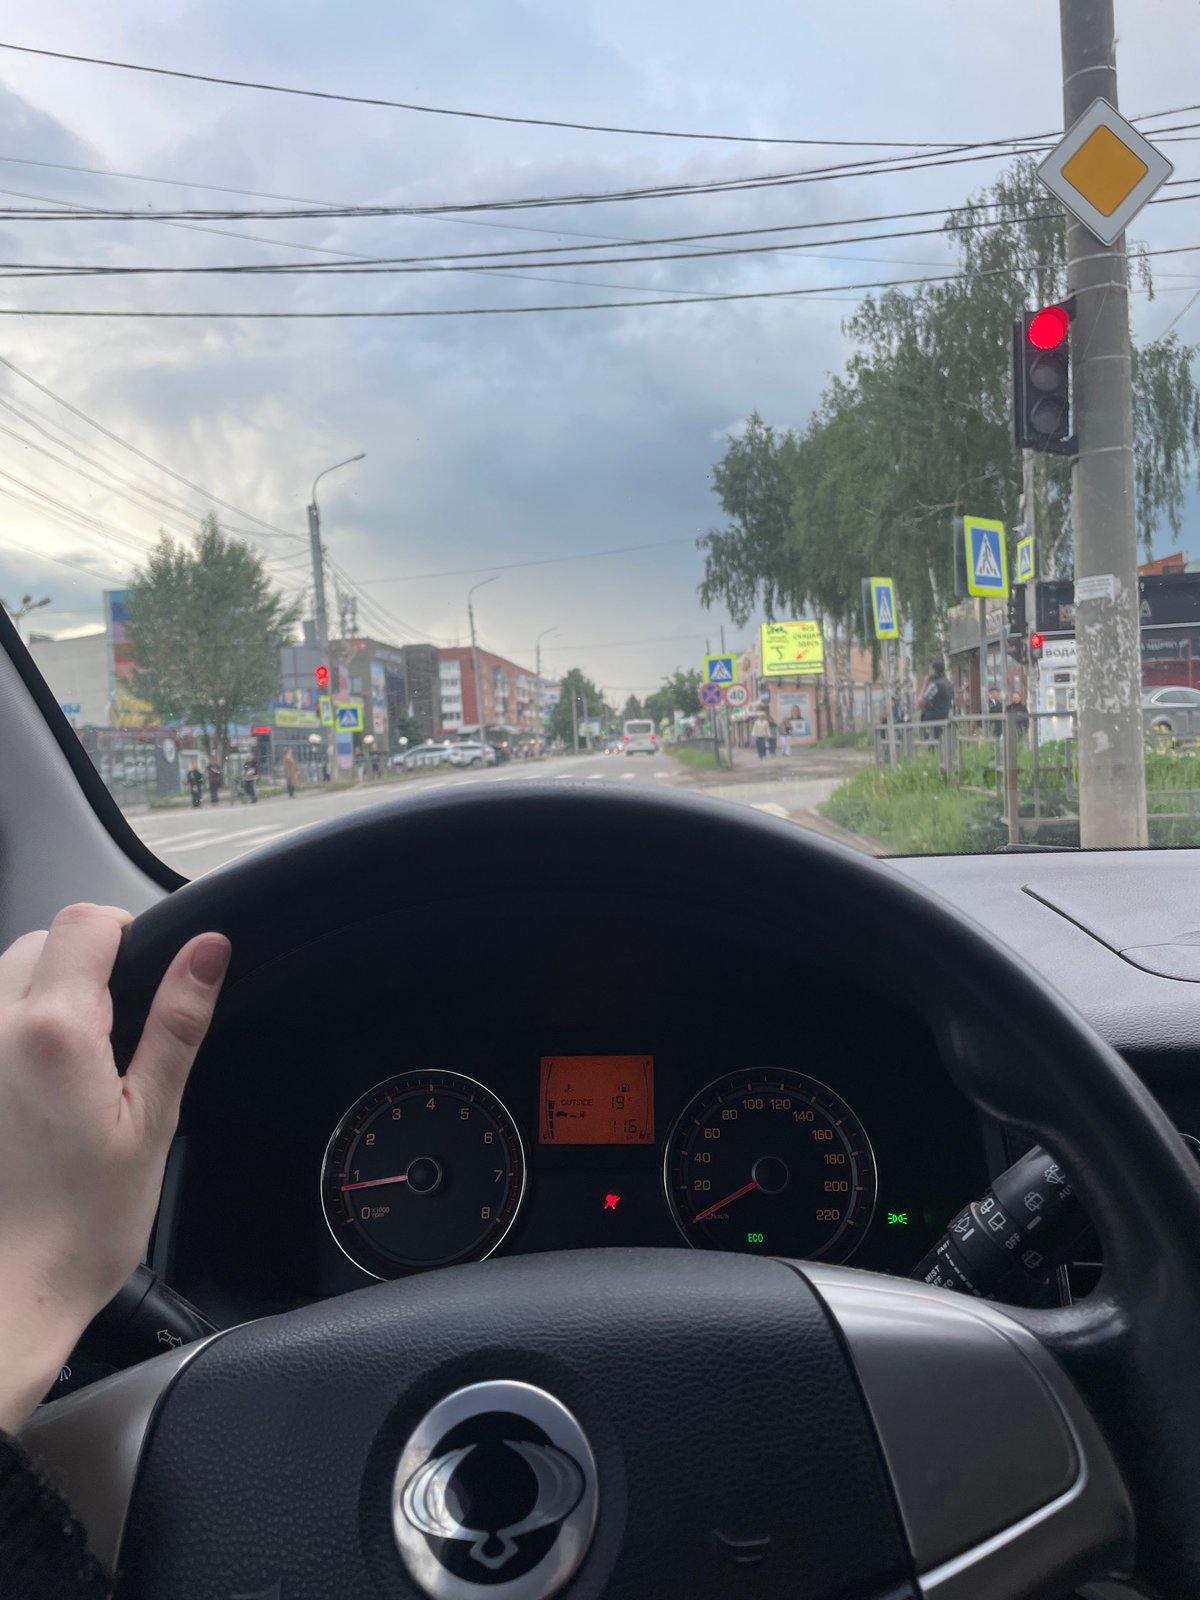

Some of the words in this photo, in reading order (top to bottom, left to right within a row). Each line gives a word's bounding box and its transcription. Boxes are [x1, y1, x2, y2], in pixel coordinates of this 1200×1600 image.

[1045, 648, 1076, 658] ВОДА
[729, 688, 744, 701] 40
[426, 1098, 435, 1110] 4
[561, 1098, 593, 1106] OUTSIDE
[611, 1095, 625, 1110] 19
[742, 1099, 763, 1110] 100
[769, 1099, 791, 1110] 120
[391, 1108, 401, 1120] 3
[460, 1108, 469, 1120] 5
[722, 1109, 738, 1120] 80
[792, 1111, 814, 1122] 140
[613, 1118, 638, 1134] 116
[366, 1133, 375, 1145] 2
[484, 1132, 493, 1144] 6
[704, 1128, 721, 1139] 60
[811, 1129, 833, 1140] 160
[694, 1152, 711, 1163] 40
[823, 1154, 845, 1165] 180
[353, 1169, 360, 1181] 1
[493, 1169, 503, 1182] 7
[694, 1180, 711, 1191] 20
[824, 1181, 848, 1192] 200
[1059, 1184, 1072, 1200] AU
[361, 1206, 371, 1219] 0
[481, 1206, 490, 1219] 8
[816, 1209, 840, 1220] 220
[747, 1233, 764, 1243] ECO
[1005, 1232, 1021, 1250] OFF
[937, 1239, 950, 1256] FAST
[924, 1264, 940, 1283] MIST
